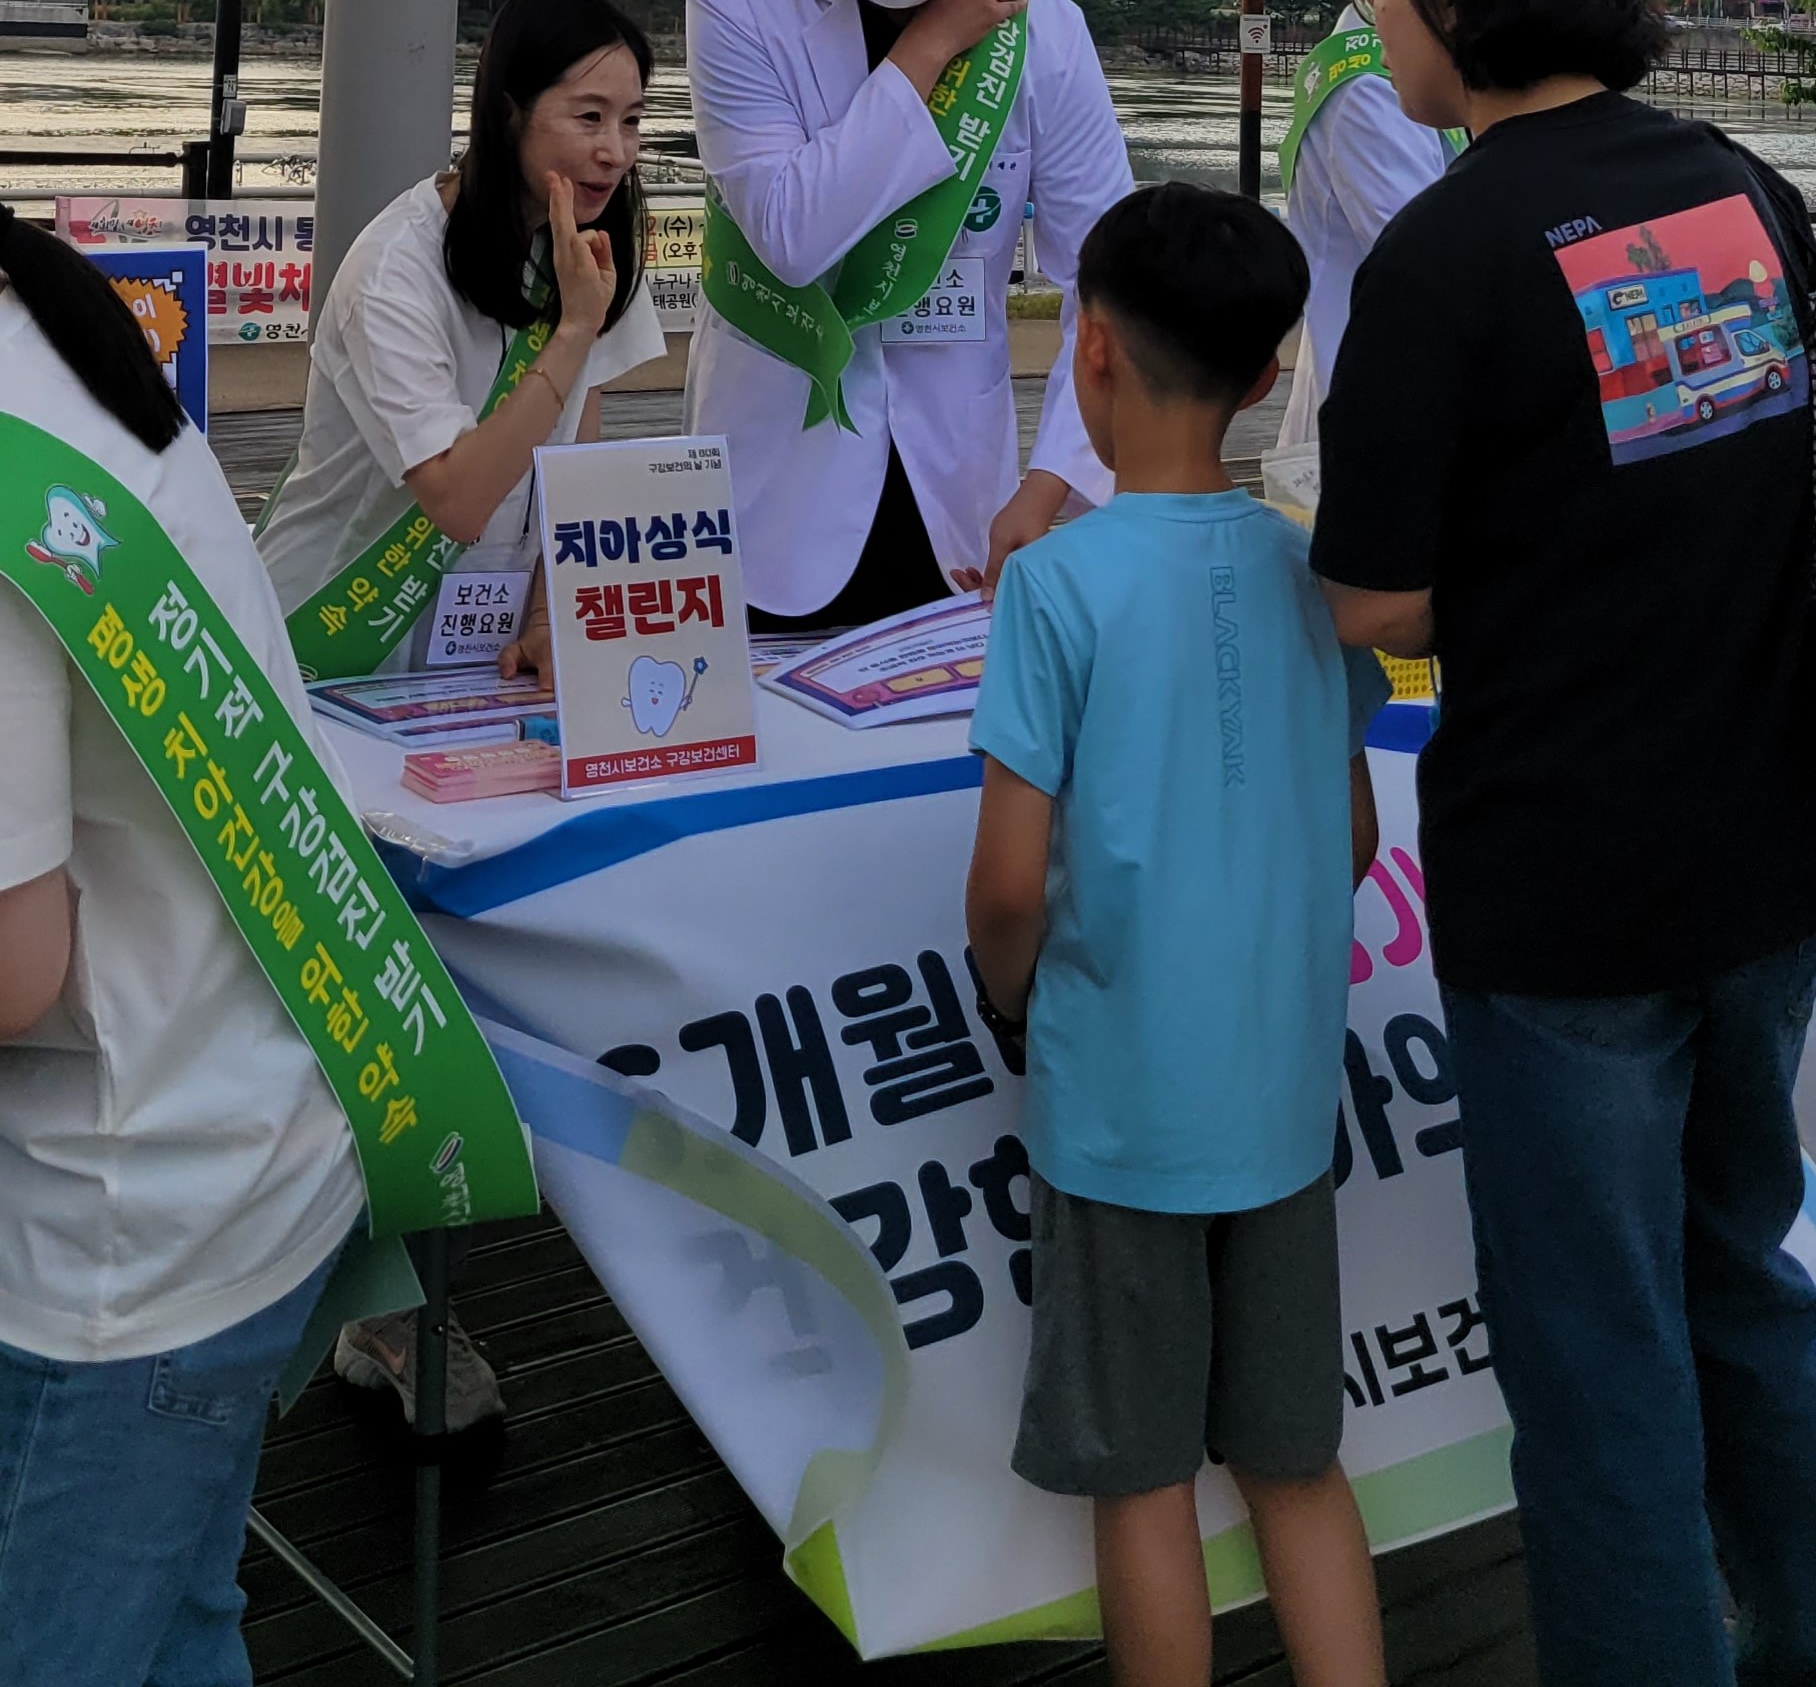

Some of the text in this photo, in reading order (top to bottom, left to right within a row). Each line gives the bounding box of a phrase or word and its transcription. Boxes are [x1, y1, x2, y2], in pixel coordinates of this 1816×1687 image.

[185, 214, 283, 252] 영천시
[1544, 215, 1602, 247] NEPA
[653, 274, 692, 290] 누구나
[896, 295, 976, 318] 행요원
[554, 509, 733, 568] 치아상식
[454, 583, 510, 606] 보건소
[575, 574, 725, 642] 챌린지
[440, 612, 514, 637] 진행요원
[1209, 566, 1246, 789] BLACKYAK
[585, 754, 662, 779] 영천시보건소
[666, 744, 740, 768] 구강보건센터
[148, 579, 448, 1056] 정기적 구강검진 받기
[86, 604, 418, 1145] 평생 치아건강을 위한 약속
[596, 945, 1025, 1157] 개월
